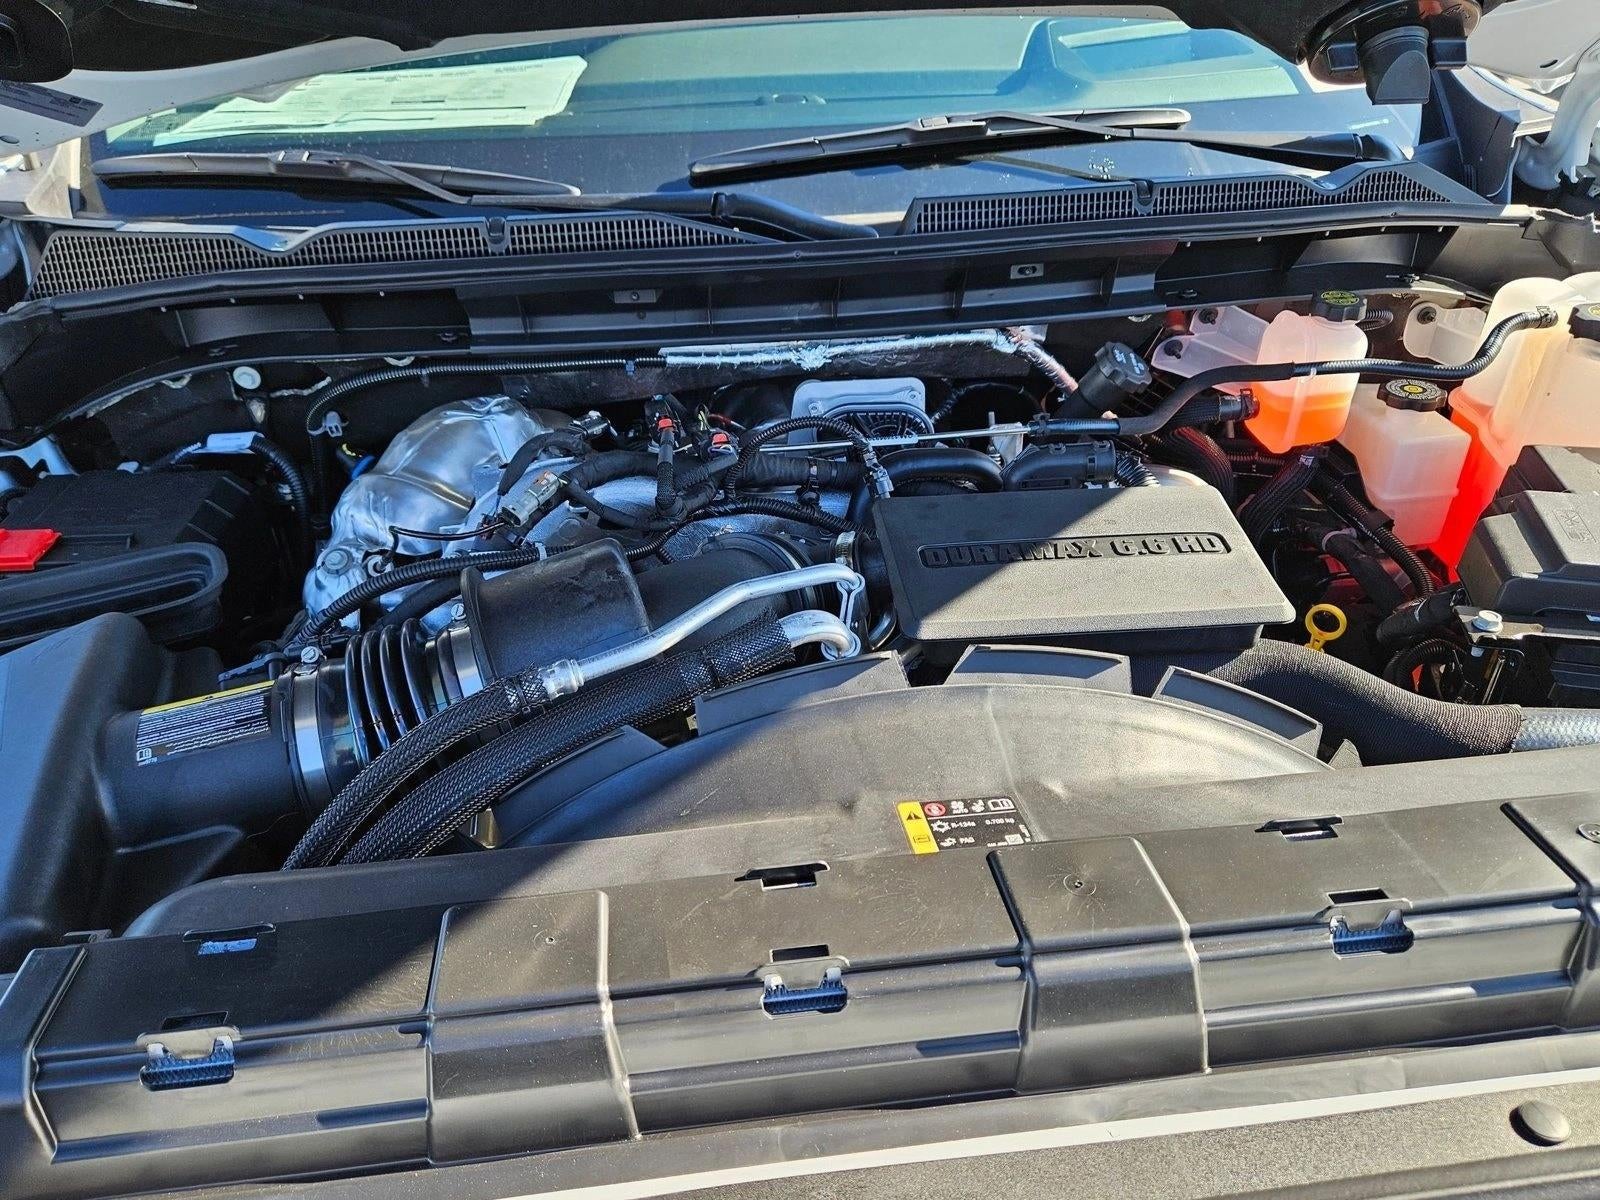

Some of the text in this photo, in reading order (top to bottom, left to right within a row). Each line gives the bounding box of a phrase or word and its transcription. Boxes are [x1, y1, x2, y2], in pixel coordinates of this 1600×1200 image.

[925, 533, 1224, 567] DURAMAX 6.6 HD
